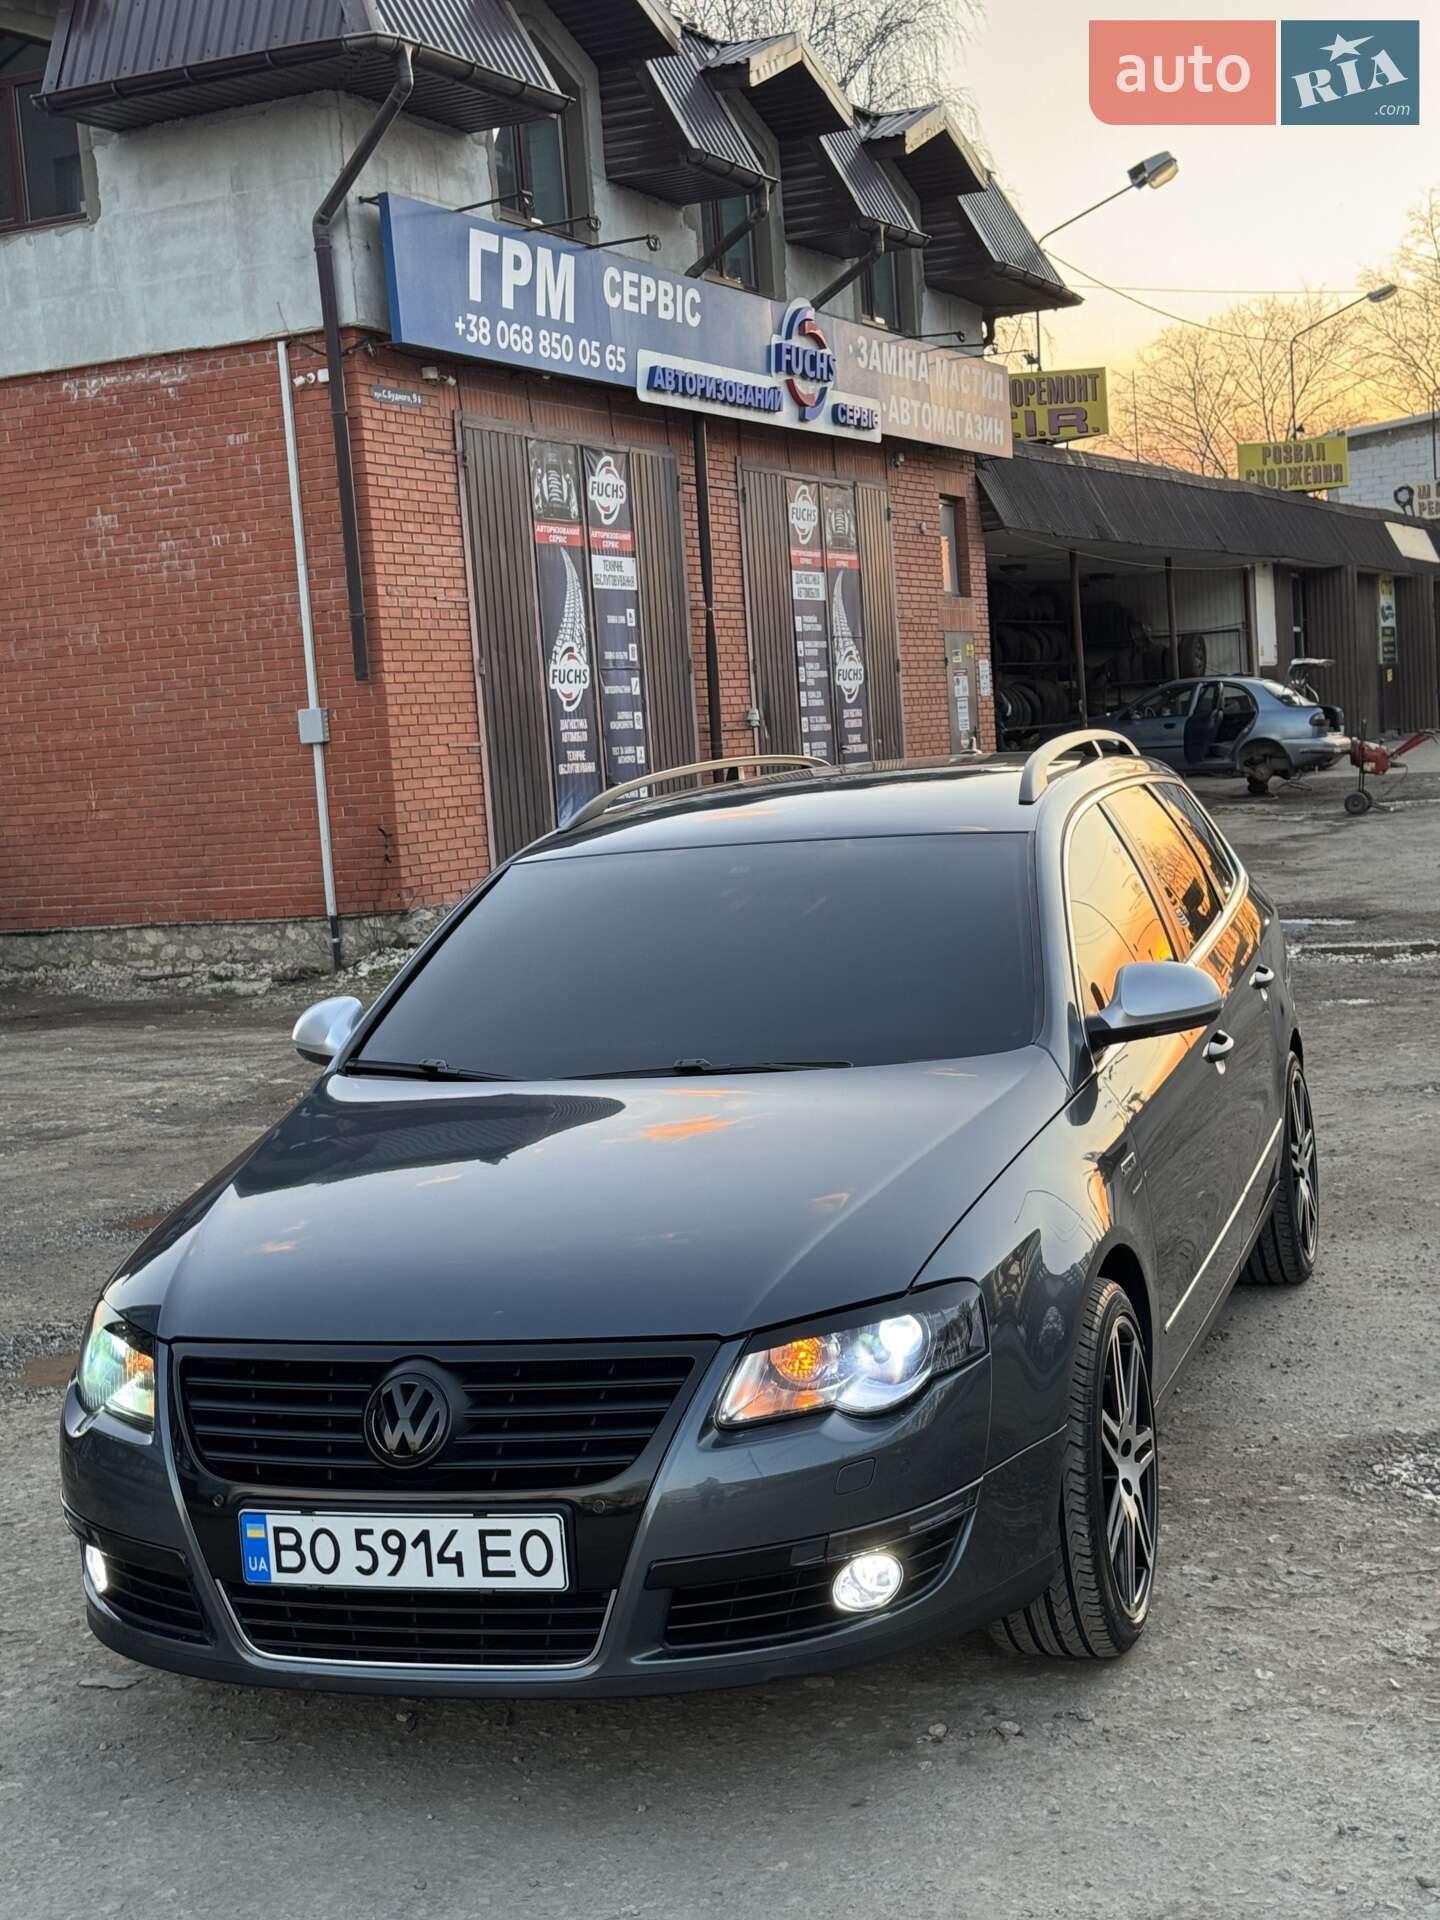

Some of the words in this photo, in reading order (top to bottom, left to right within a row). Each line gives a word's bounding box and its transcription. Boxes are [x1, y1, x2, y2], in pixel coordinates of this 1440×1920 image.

[468, 227, 575, 323] ГРМ
[602, 266, 701, 327] СЕРВІС
[455, 313, 491, 346] +38
[496, 320, 533, 354] 068
[538, 329, 573, 362] 850
[578, 338, 601, 368] 05
[605, 344, 626, 373] 65
[778, 332, 837, 382] FUCHS
[650, 365, 784, 411] АВТОРИЗОВАНИЙ
[856, 335, 929, 384] ЗАМІНА
[935, 356, 1004, 401] МАСТИЛ
[1009, 373, 1099, 407] ОРЕМОНТ
[835, 402, 879, 429] СЕРВІС
[888, 395, 1004, 447] АВТОМАГАЗИН
[1262, 442, 1326, 465] РОЗВАЛ
[591, 480, 625, 500] FUCHS
[791, 507, 818, 523] FUCHS
[552, 668, 588, 685] FUCHS
[837, 668, 863, 682] FUCHS
[373, 1381, 442, 1457] VW
[248, 1555, 268, 1573] UA
[272, 1525, 341, 1575] BO
[354, 1528, 465, 1578] 5914
[477, 1528, 554, 1578] EO
